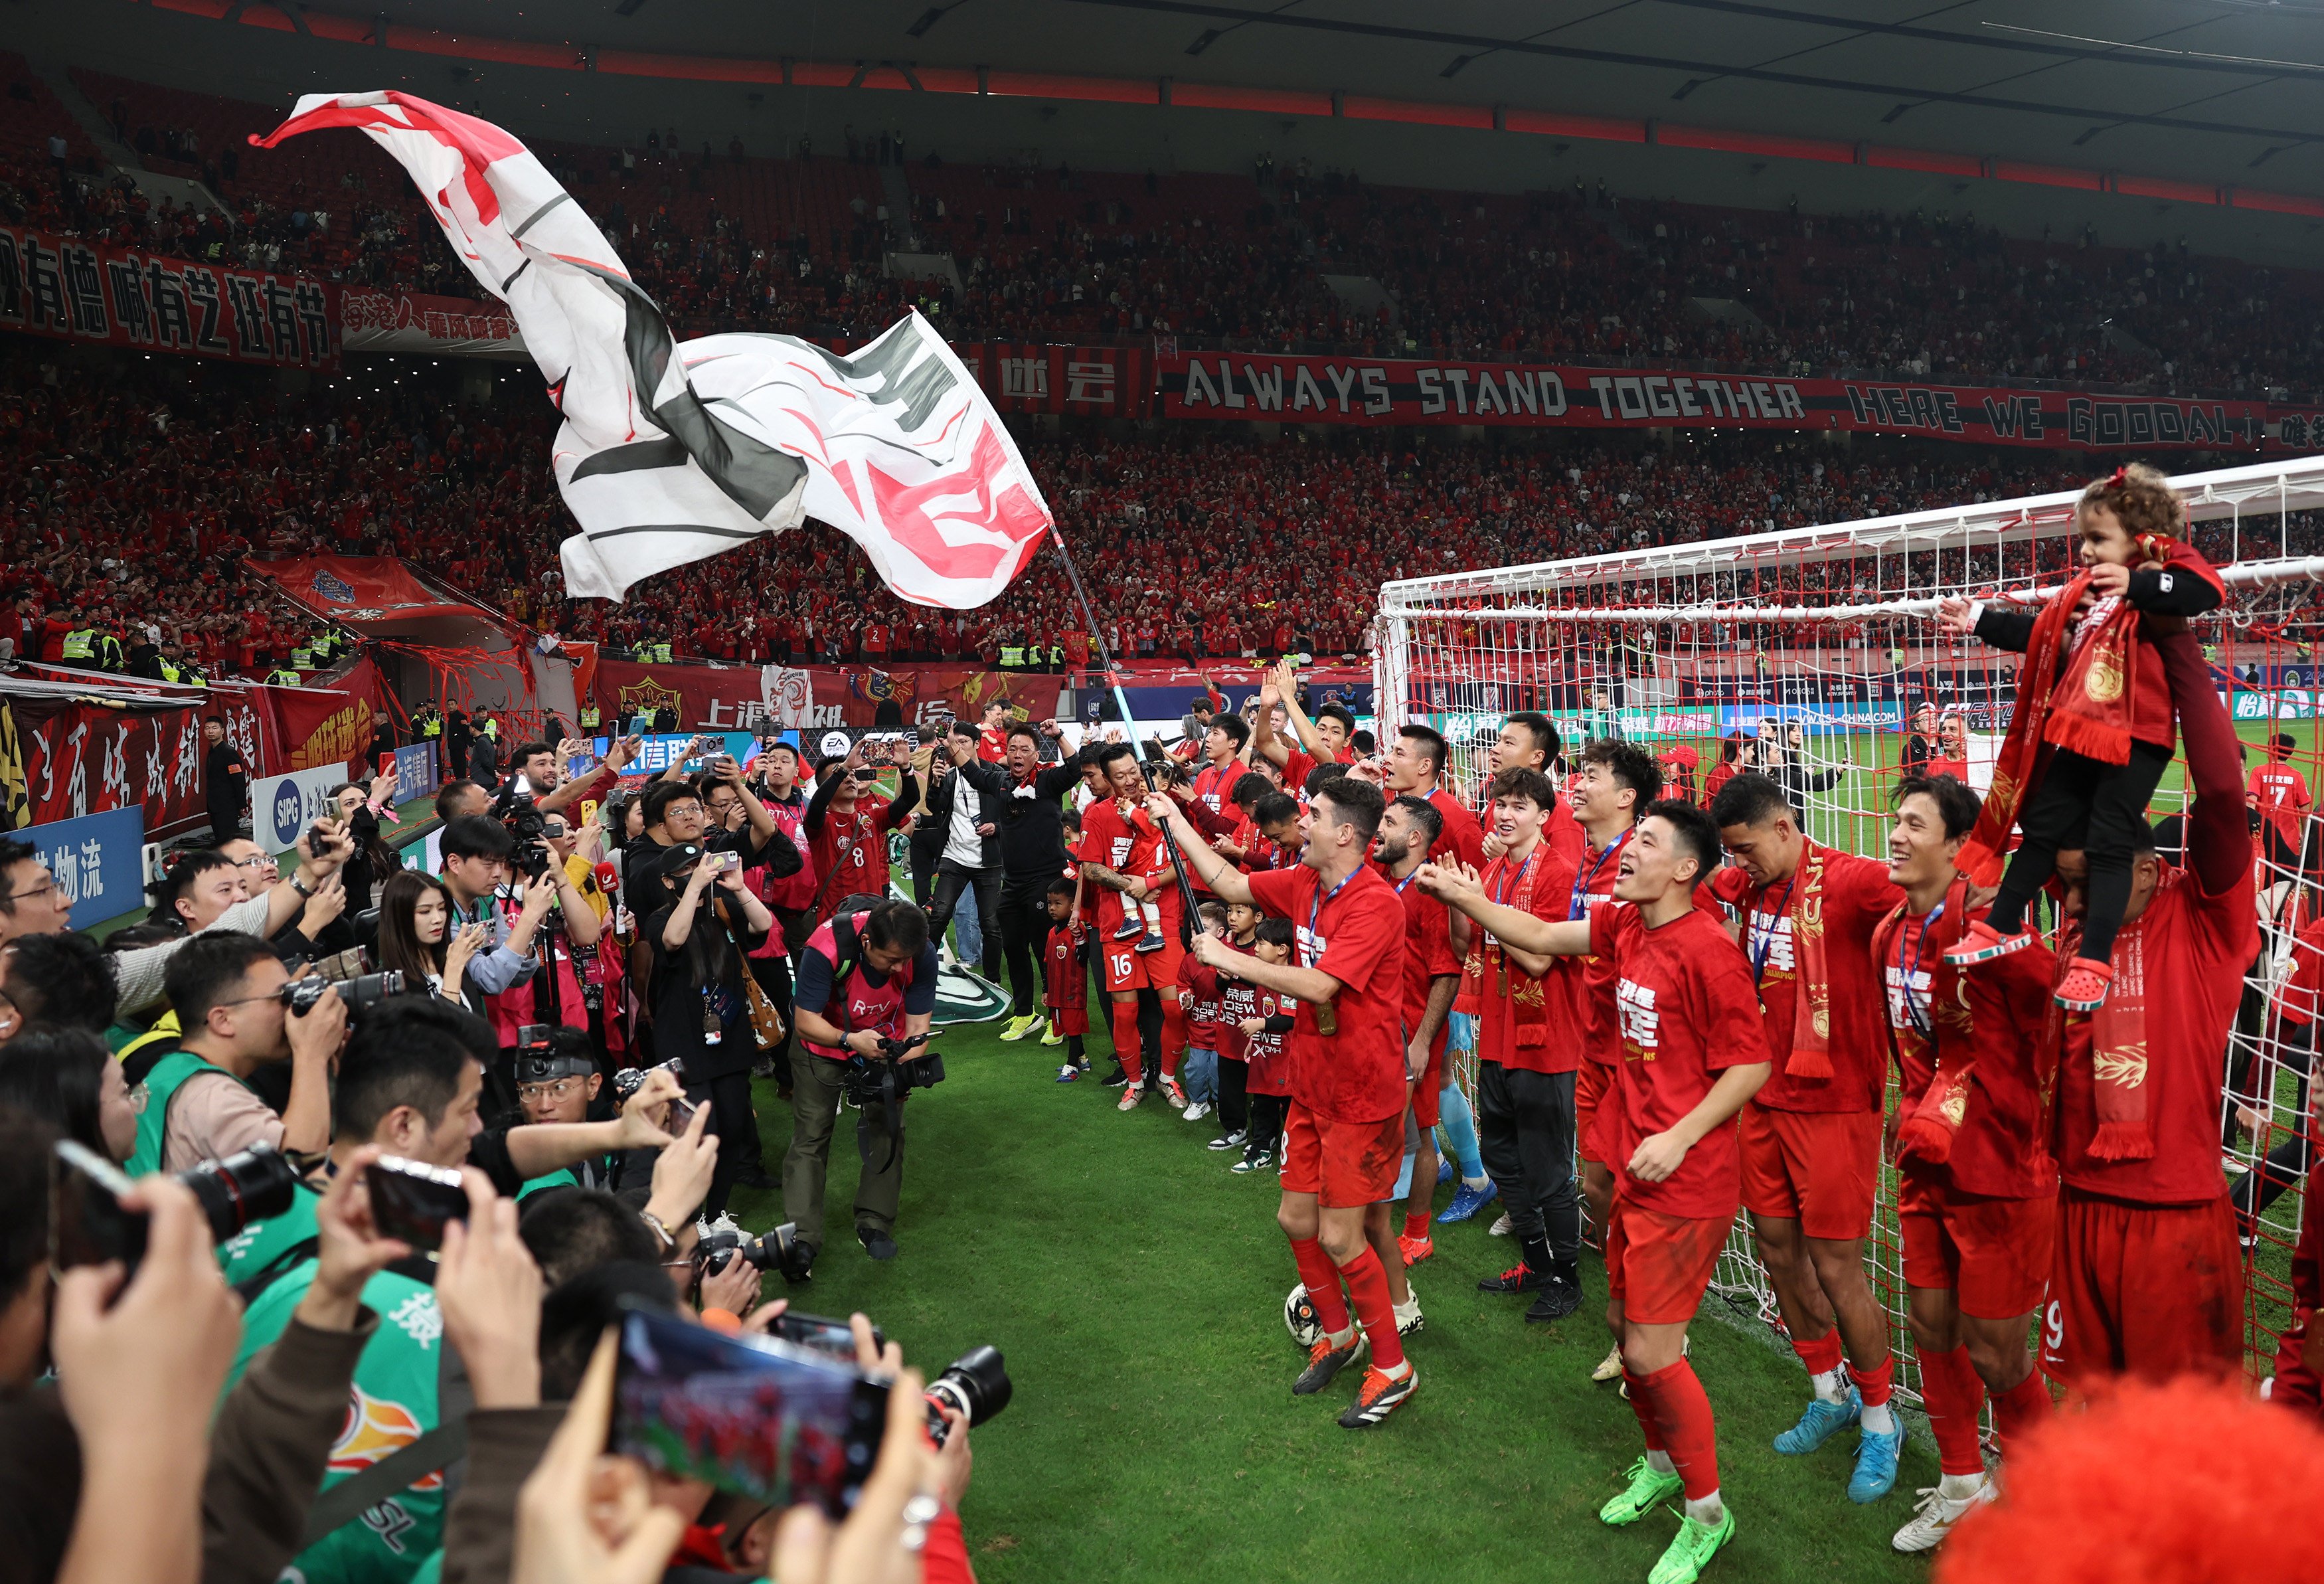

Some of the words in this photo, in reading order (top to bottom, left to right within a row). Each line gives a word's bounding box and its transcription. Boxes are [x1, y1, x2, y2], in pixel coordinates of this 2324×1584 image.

[106, 254, 230, 349] 喊有艺
[963, 357, 1115, 402] 迷会
[1183, 358, 1392, 416] ALWAYS
[1416, 367, 1567, 416] STAND
[1589, 376, 1805, 420] TOGETHER
[1845, 385, 1964, 434] HERE
[1983, 395, 2045, 440] WE
[2067, 397, 2234, 446] GOOOAL
[872, 630, 878, 640] 2
[394, 750, 429, 796] 上汽集团
[278, 796, 299, 829] SIPG
[768, 809, 790, 821] RTV
[853, 847, 865, 867] 8
[1111, 954, 1132, 977] 16
[1764, 969, 1796, 980] CHAMPIO
[1226, 988, 1254, 1002] 荣威
[853, 999, 891, 1015] RTV
[1222, 1000, 1256, 1014] OEW
[1265, 1045, 1282, 1054] DMH
